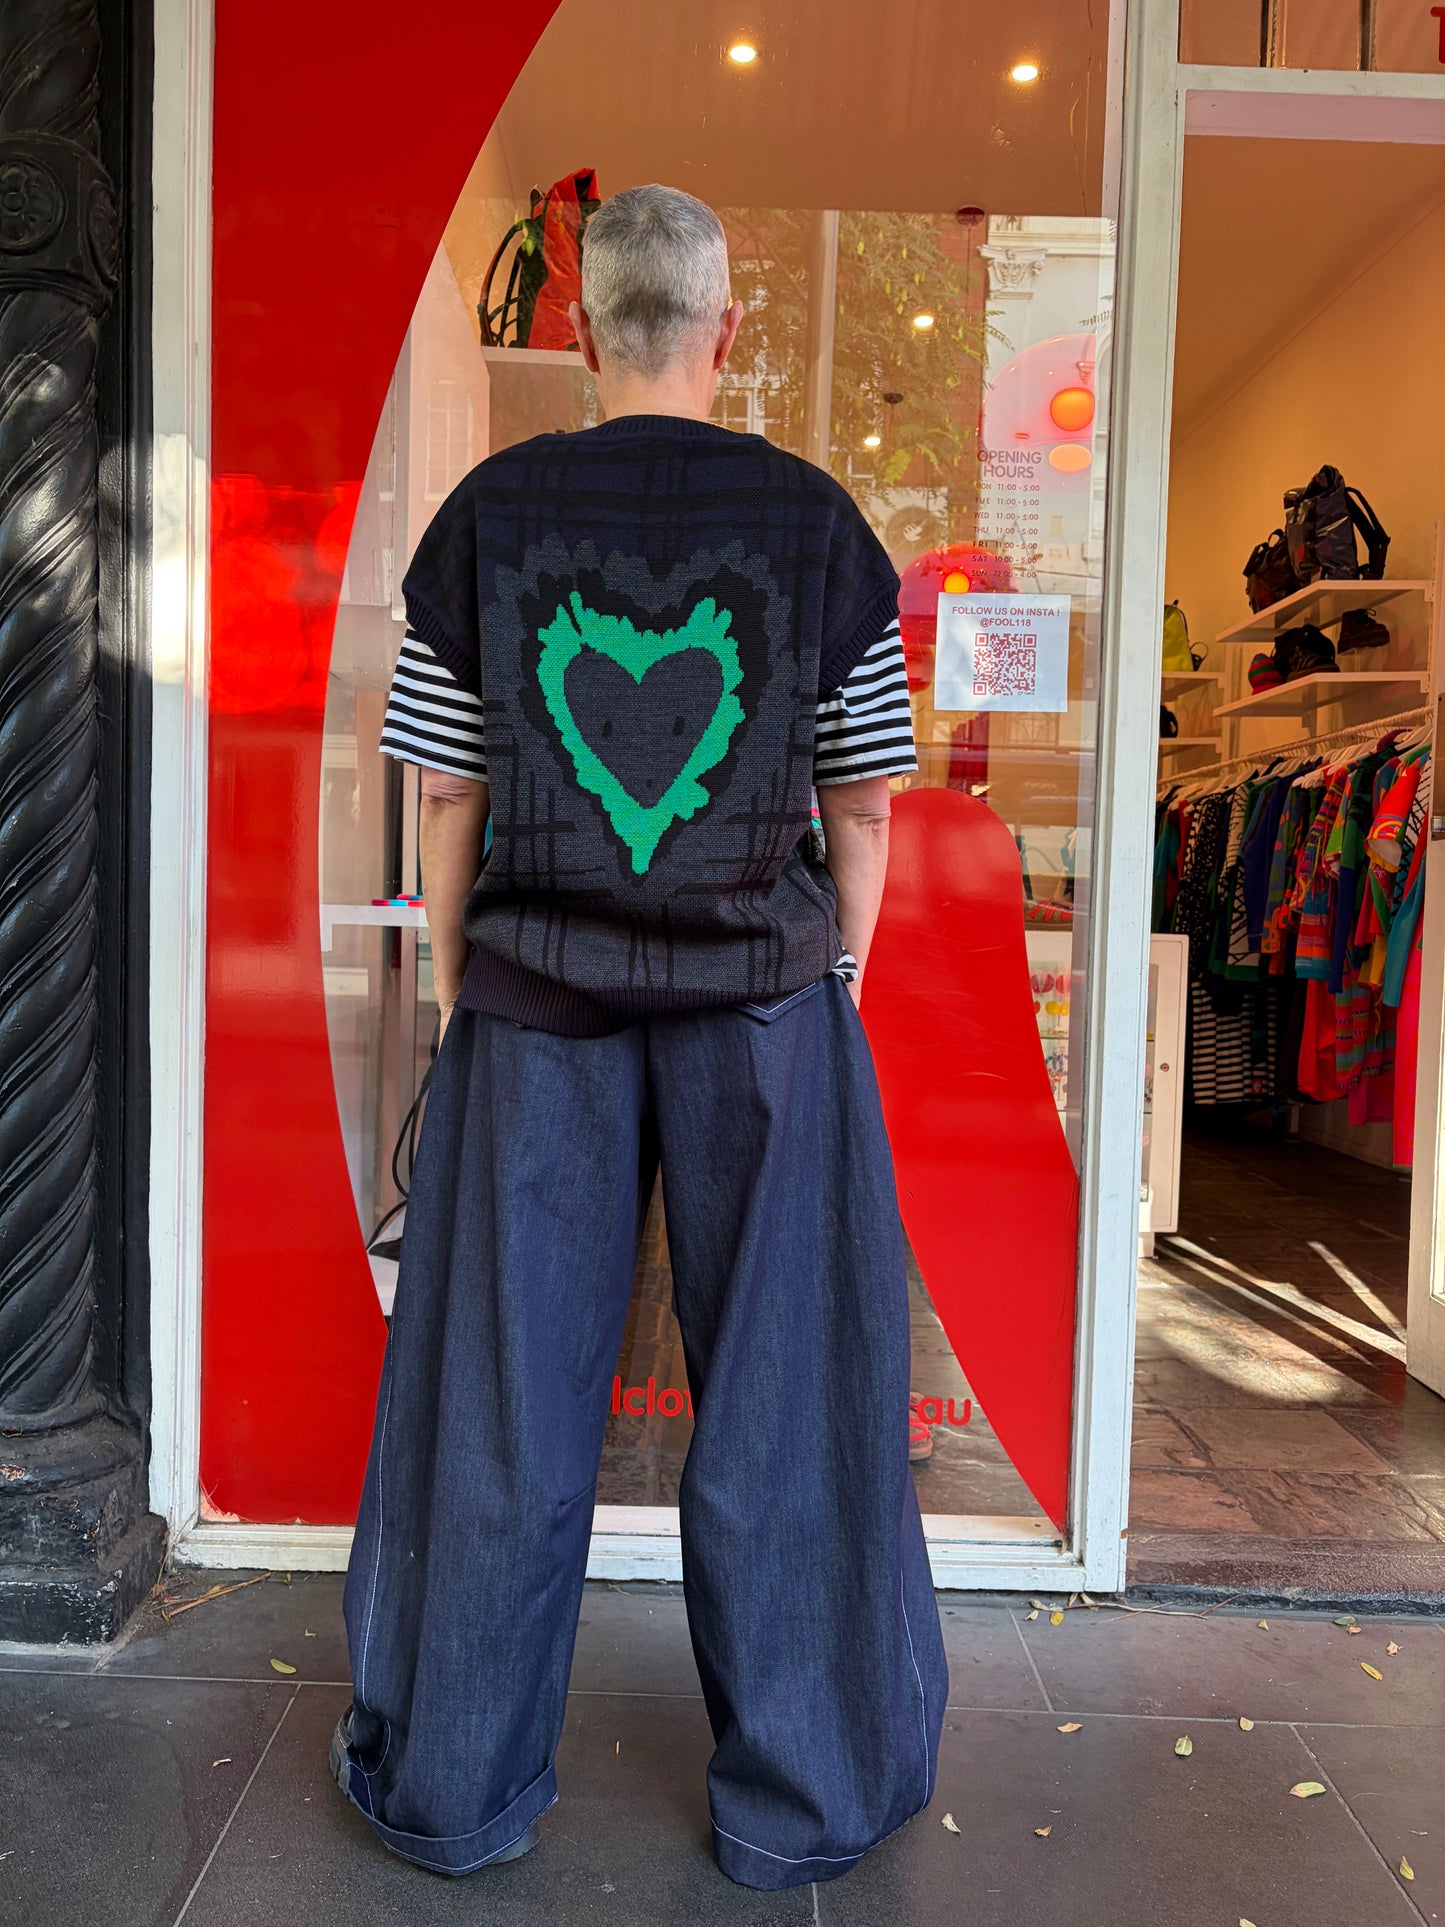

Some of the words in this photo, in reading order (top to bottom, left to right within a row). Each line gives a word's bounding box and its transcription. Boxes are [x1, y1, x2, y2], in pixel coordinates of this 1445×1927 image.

[977, 449, 1042, 464] OPENING
[983, 465, 1035, 479] HOURS
[975, 497, 990, 505] TUE
[973, 526, 989, 534] THU
[972, 540, 988, 548] FRI
[951, 606, 993, 615] FOLLOW
[994, 607, 1008, 615] US
[1009, 607, 1024, 616] ON
[1026, 608, 1055, 617] INSTA
[979, 617, 1031, 627] @FOOL118
